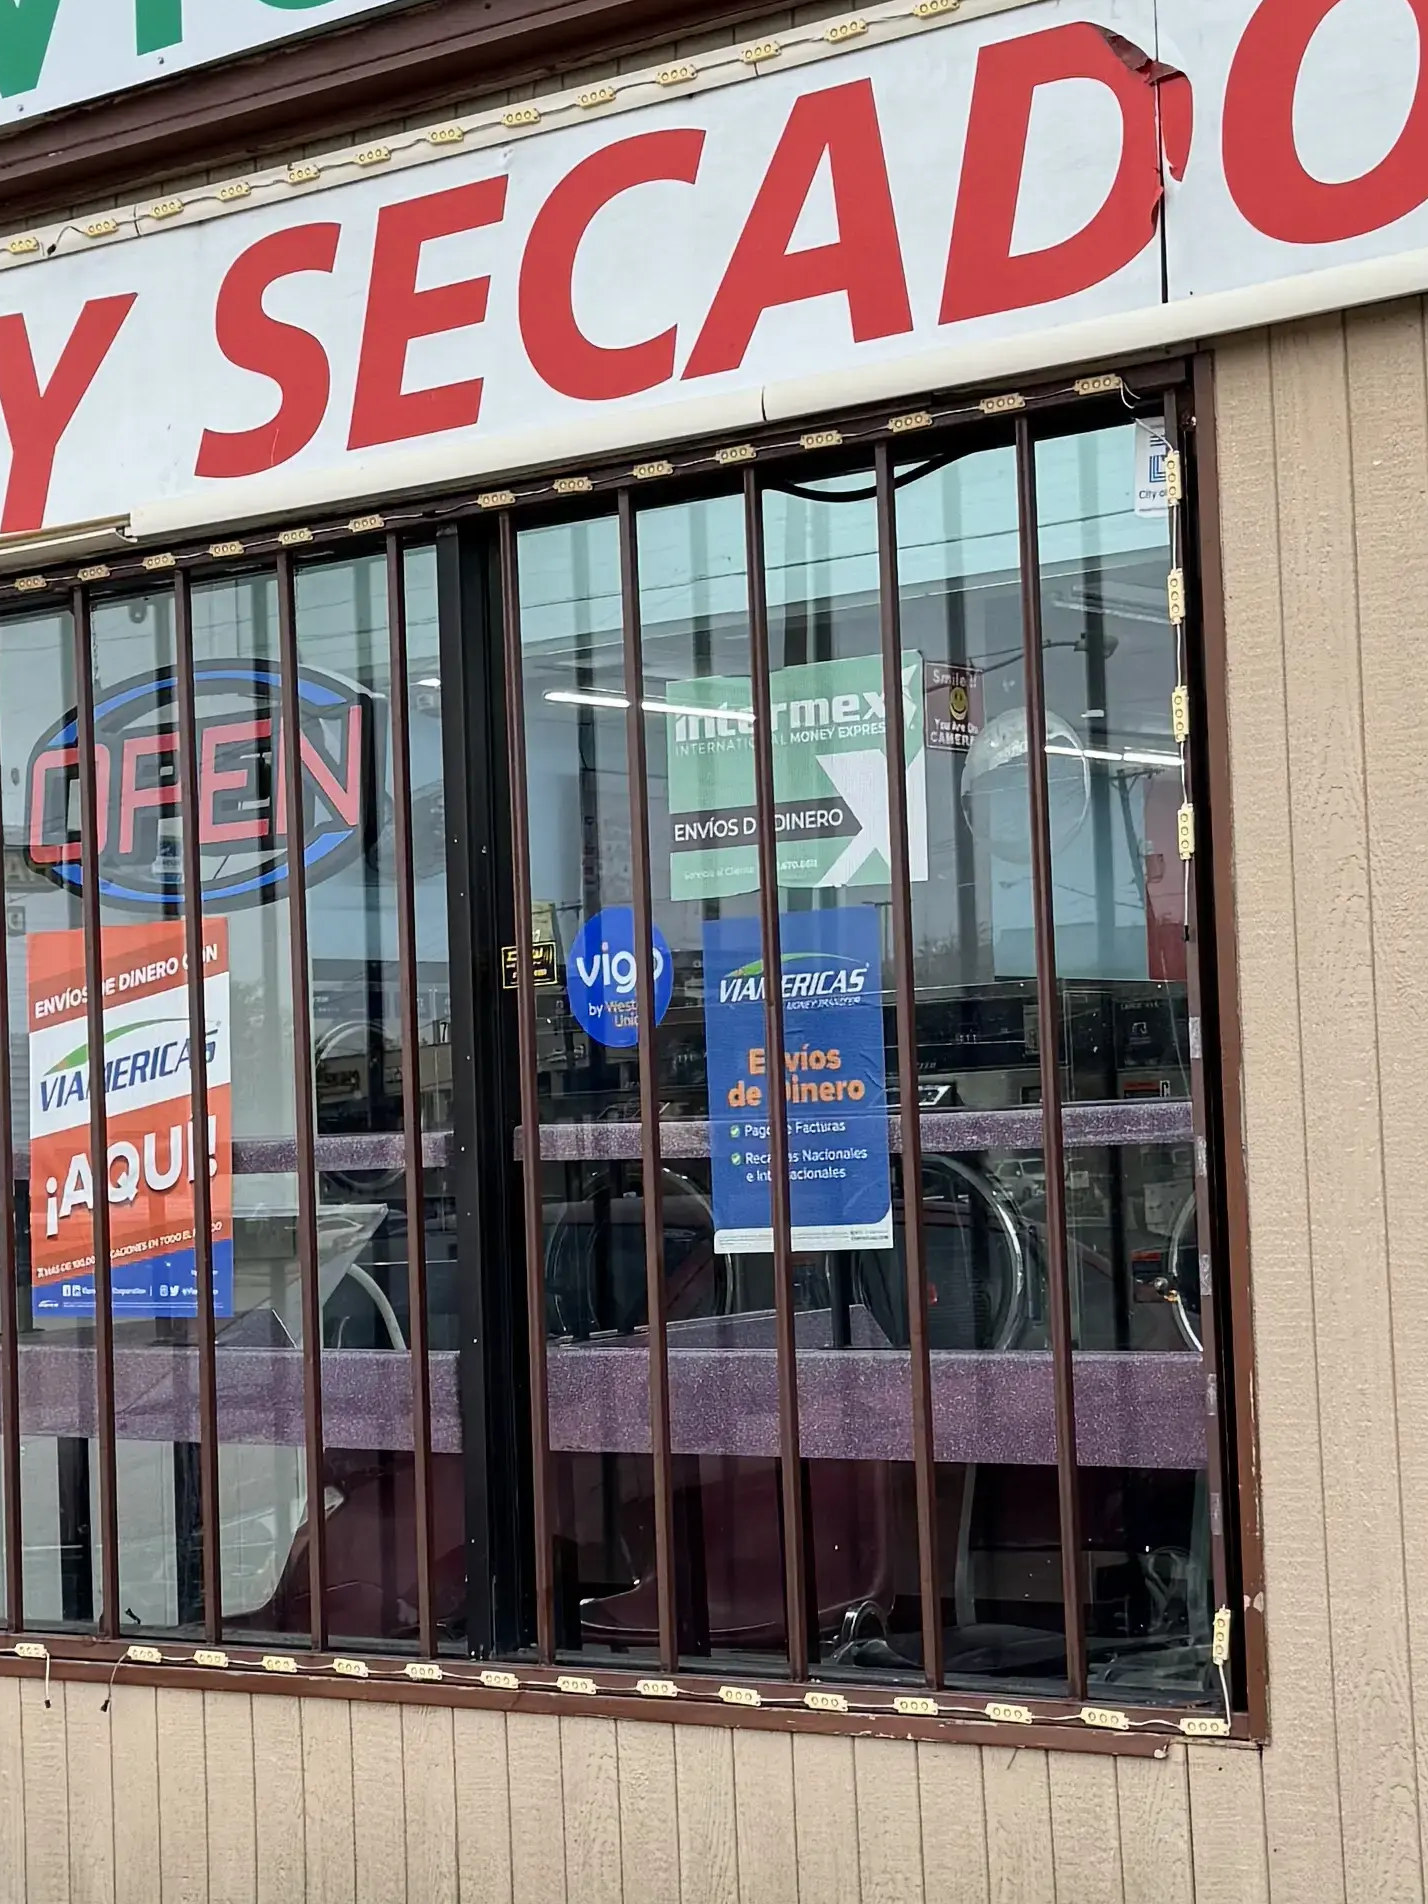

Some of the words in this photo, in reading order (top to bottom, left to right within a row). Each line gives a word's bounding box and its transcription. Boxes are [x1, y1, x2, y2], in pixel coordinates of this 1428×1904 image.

[675, 732, 788, 757] INTERNATIAL
[790, 726, 835, 744] MONEY
[838, 720, 886, 739] EXPRES
[930, 731, 975, 747] CAMER
[29, 704, 363, 864] OPEN
[674, 816, 739, 842] ENVÍOS
[774, 808, 844, 833] DINERO
[35, 985, 88, 1019] ENVÍOS
[119, 957, 179, 991] DINERO
[181, 943, 219, 971] CN
[589, 1002, 604, 1018] by
[605, 1000, 638, 1014] West
[748, 1042, 842, 1076] Evíos
[728, 1079, 763, 1108] de
[785, 1073, 866, 1104] inero
[795, 1120, 847, 1135] Facturas
[745, 1150, 799, 1166] Recaas
[802, 1147, 868, 1163] Nacionales
[757, 1166, 847, 1183] Intacionales
